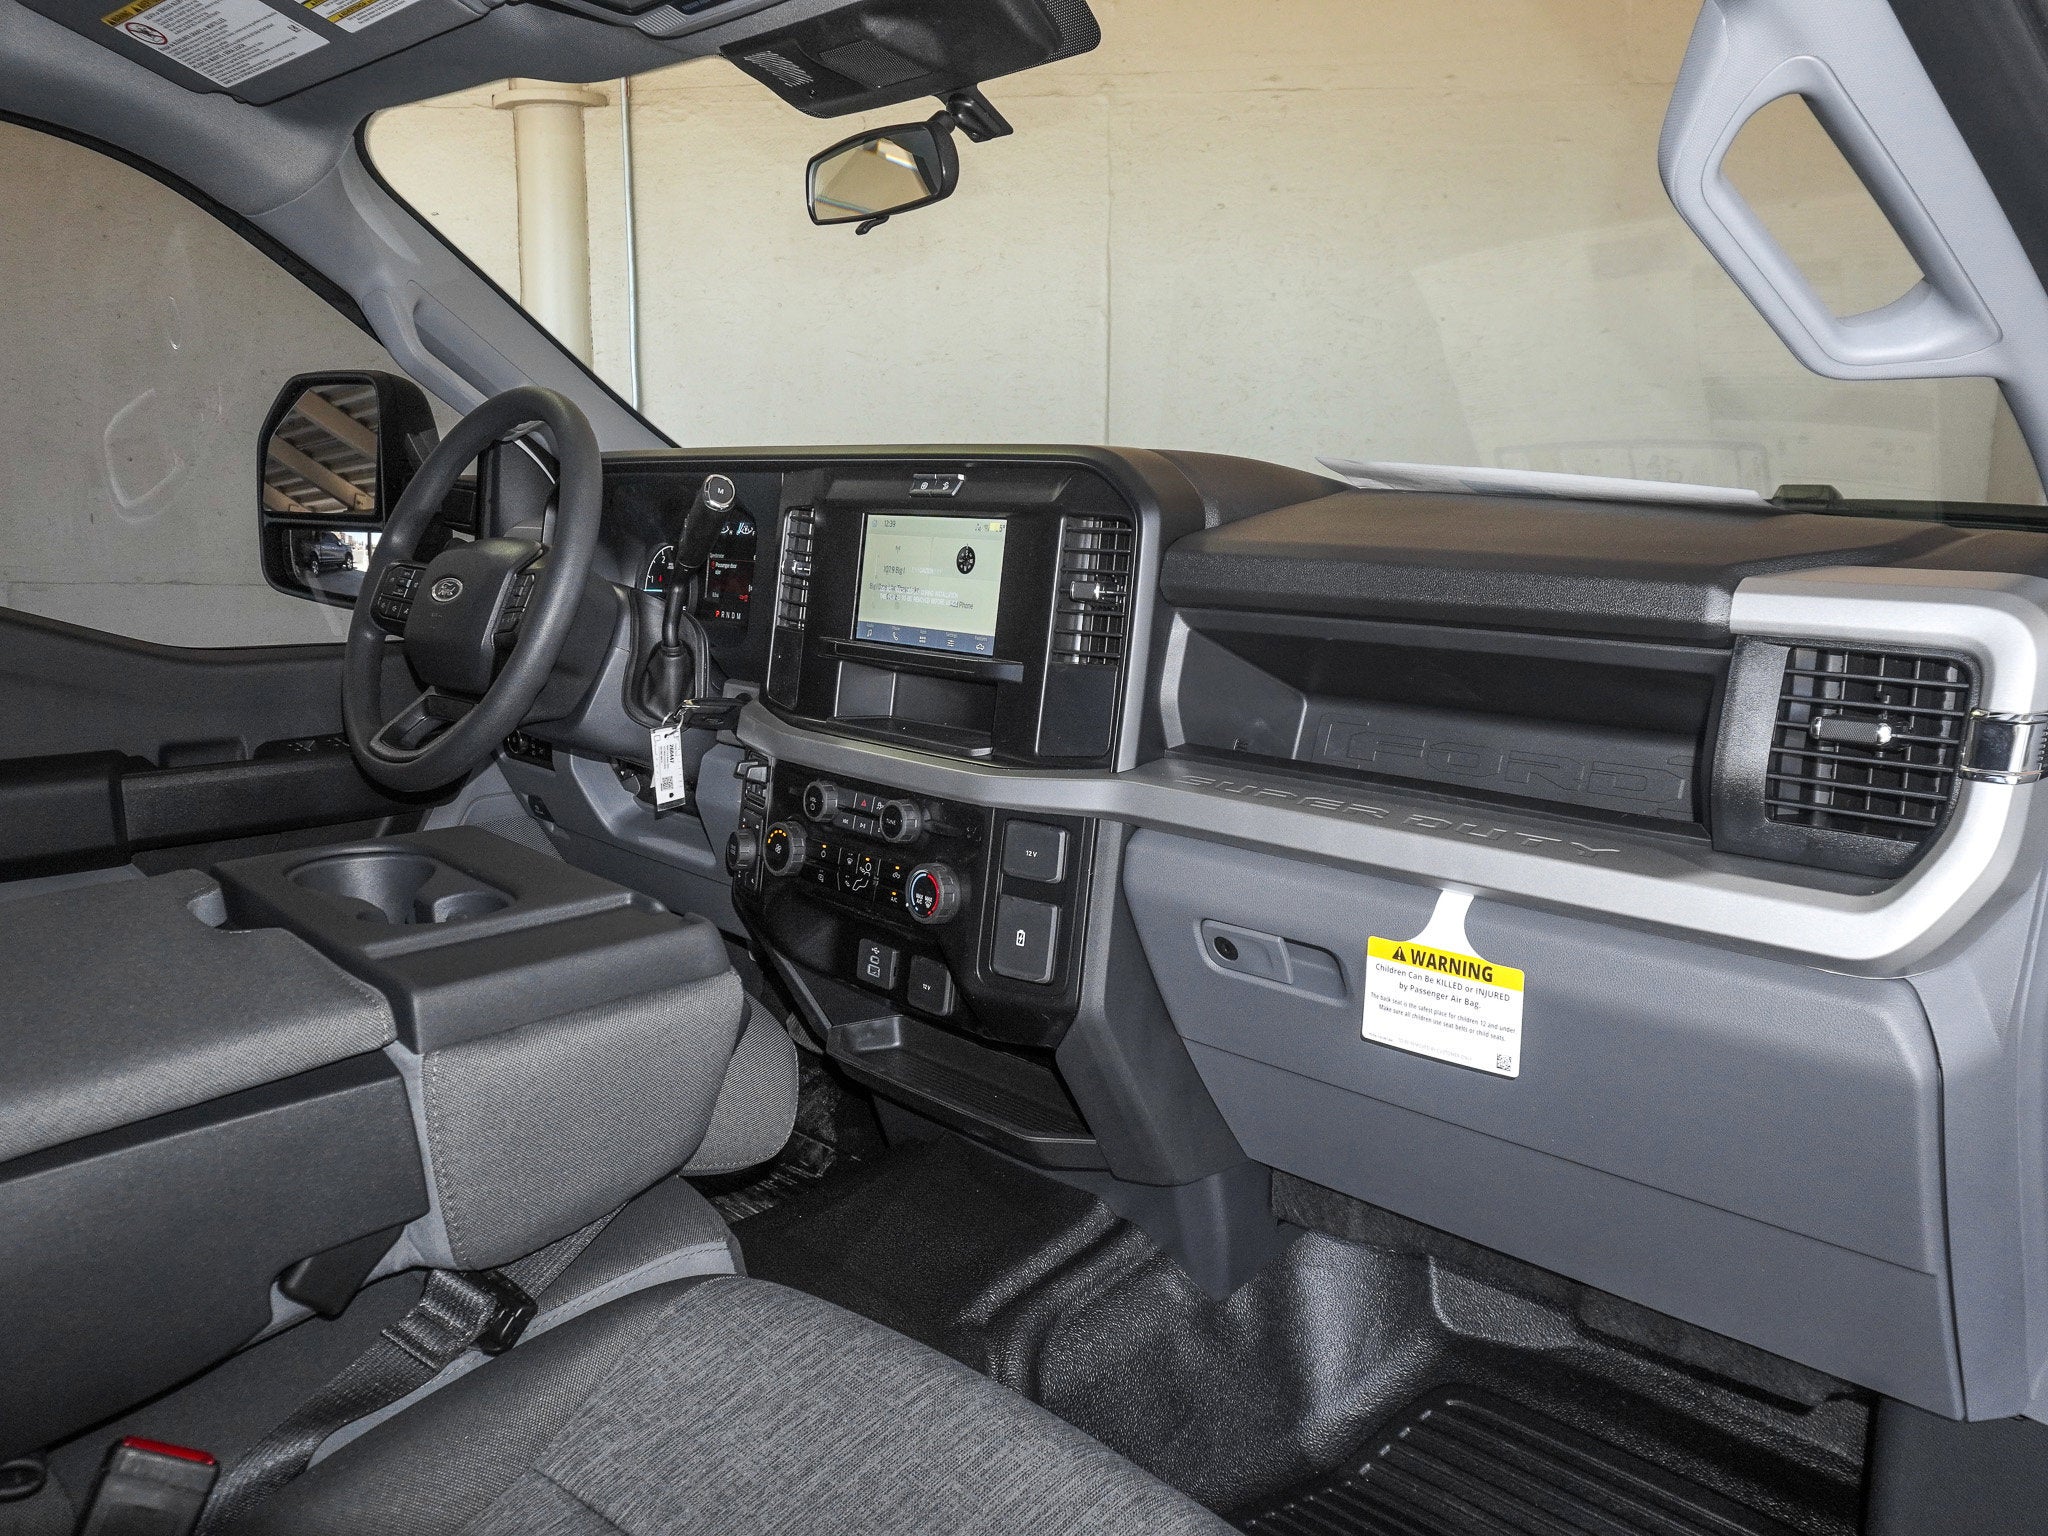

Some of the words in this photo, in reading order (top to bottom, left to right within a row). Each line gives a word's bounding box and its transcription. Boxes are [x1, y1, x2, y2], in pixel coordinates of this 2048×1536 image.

[717, 487, 725, 495] M
[1174, 774, 1390, 820] SUPER
[1401, 813, 1621, 858] DUTY
[1411, 948, 1493, 982] WARNING
[1376, 962, 1406, 976] Children
[1409, 970, 1422, 980] Can
[1425, 974, 1433, 983] Be
[1437, 977, 1462, 990] KILLED
[1476, 987, 1509, 1002] INJURED
[1399, 981, 1407, 991] by
[1410, 984, 1448, 1001] Passenger
[1451, 994, 1461, 1003] Air
[1465, 998, 1480, 1009] Bag.
[1409, 1001, 1417, 1009] the
[1419, 1004, 1432, 1013] safest
[1434, 1008, 1447, 1017] place
[1458, 1014, 1478, 1024] children
[1412, 1012, 1431, 1022] children
